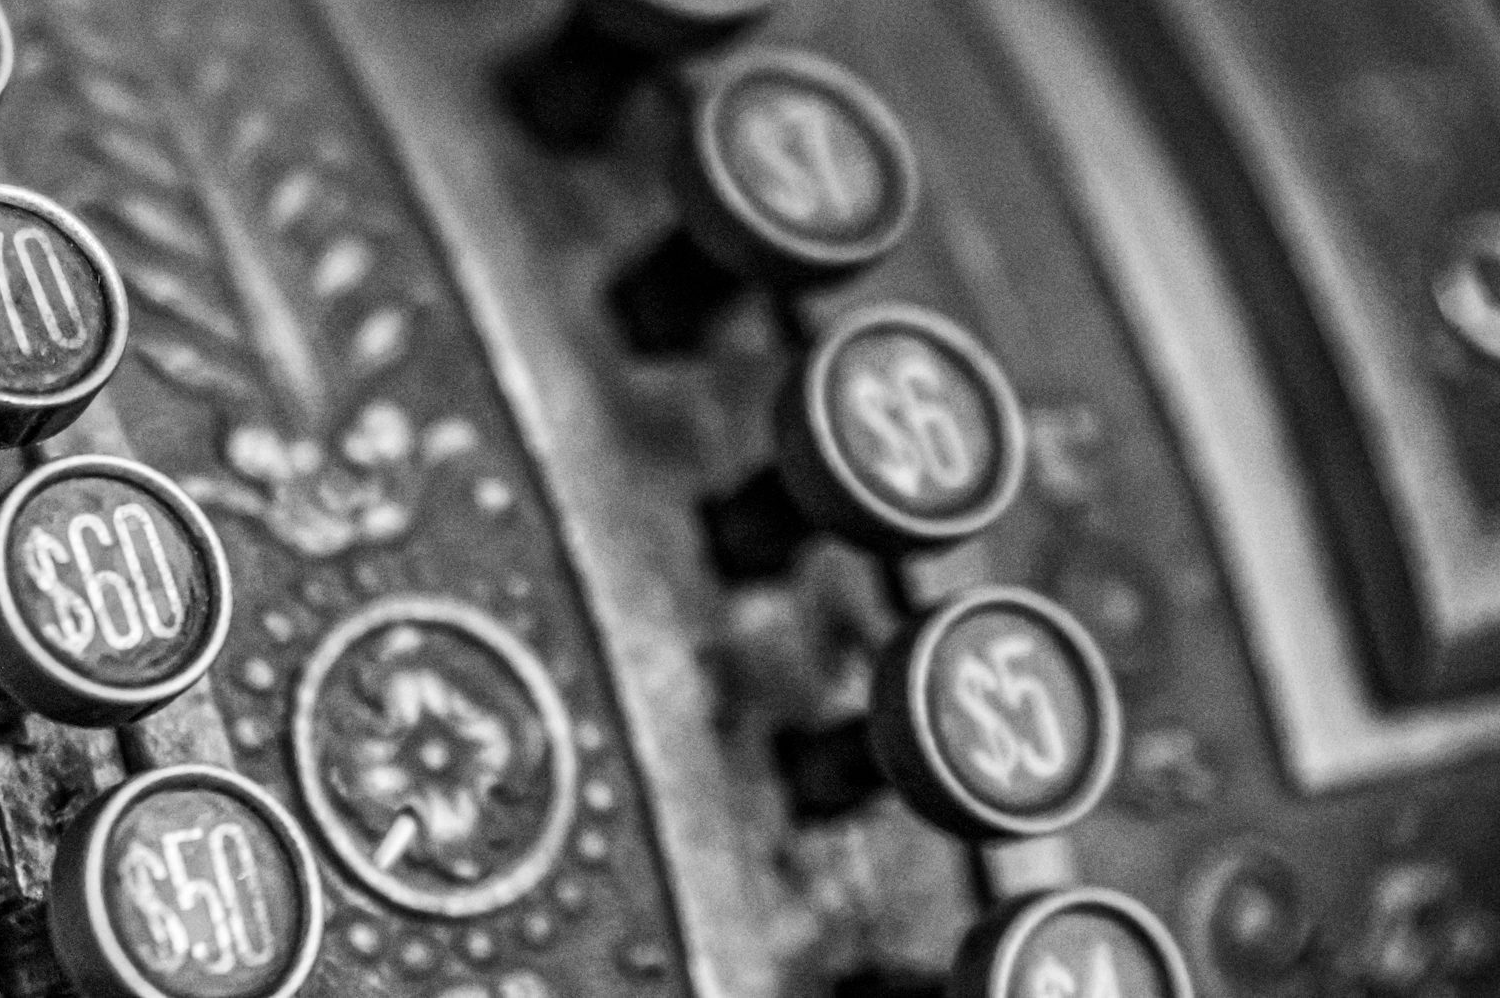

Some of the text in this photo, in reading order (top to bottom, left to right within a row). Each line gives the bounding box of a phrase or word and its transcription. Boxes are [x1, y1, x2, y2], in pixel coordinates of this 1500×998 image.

[846, 352, 972, 498] $6
[26, 502, 183, 656] $60
[950, 634, 1065, 788] $5
[119, 822, 275, 975] $50
